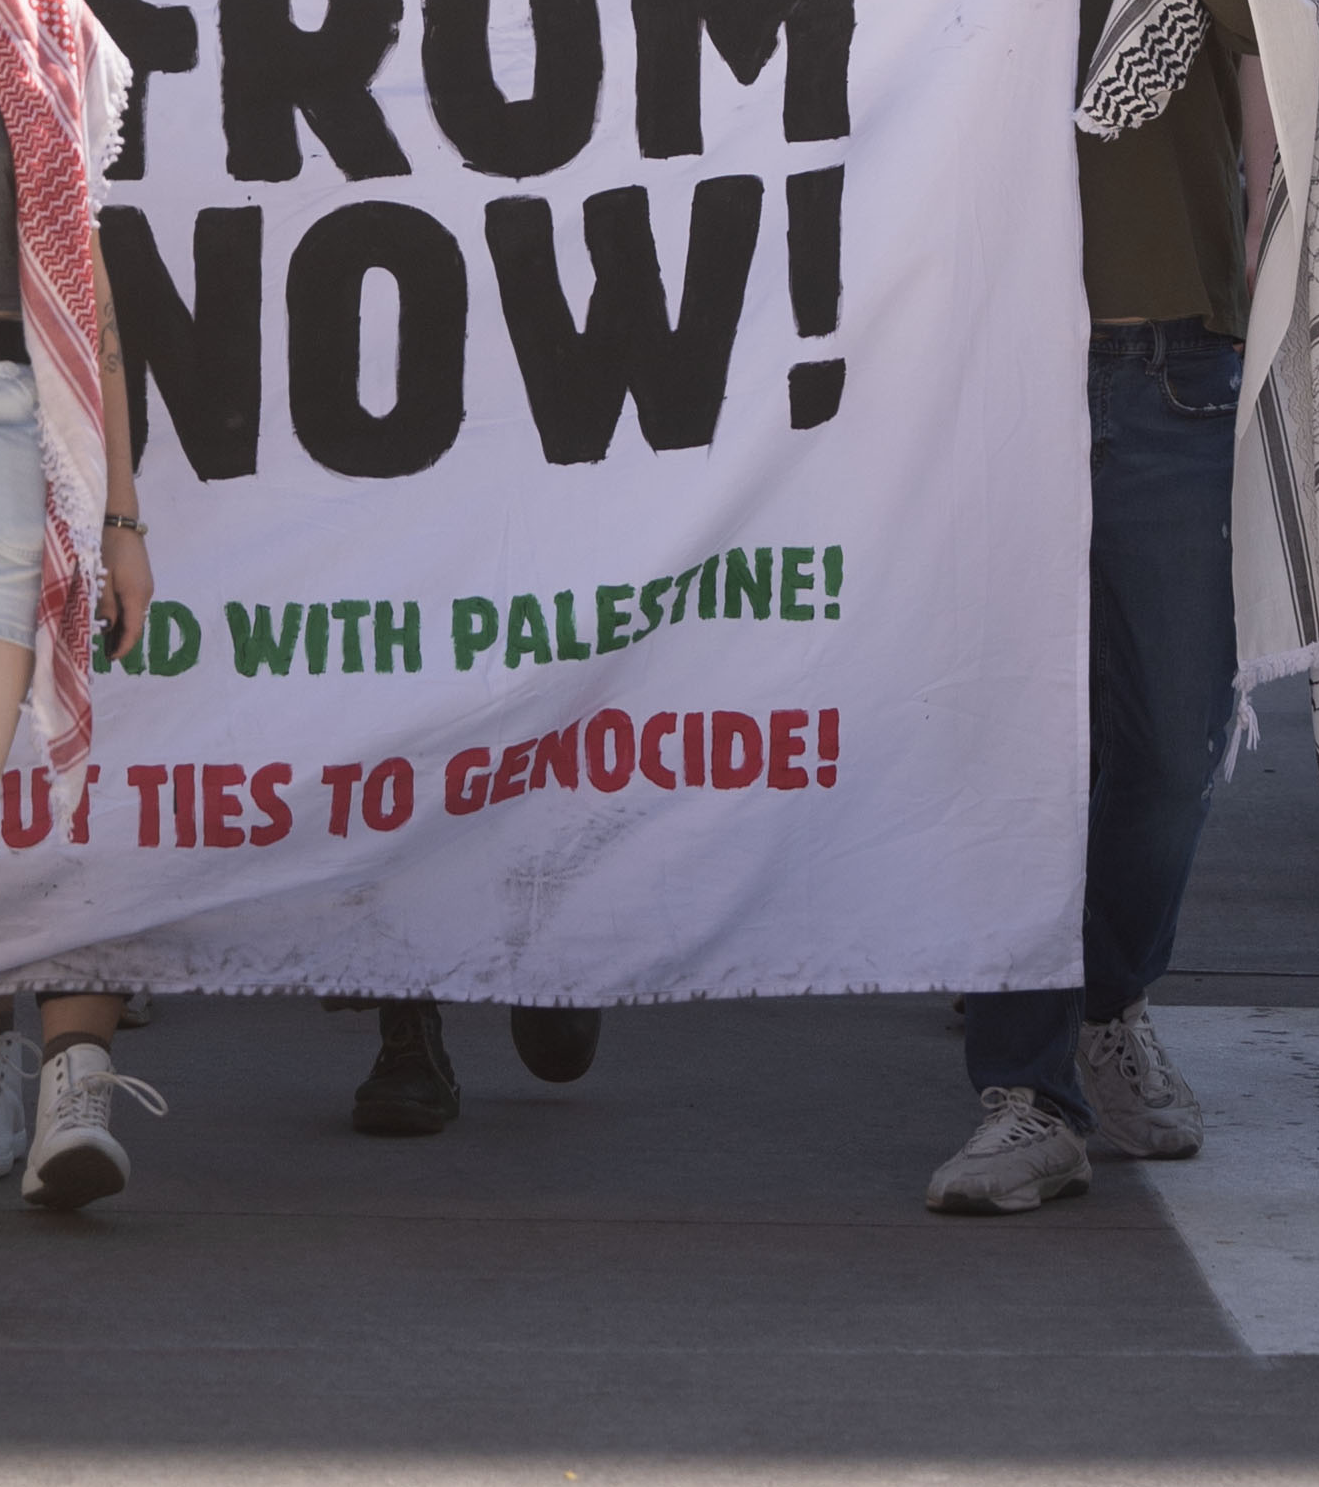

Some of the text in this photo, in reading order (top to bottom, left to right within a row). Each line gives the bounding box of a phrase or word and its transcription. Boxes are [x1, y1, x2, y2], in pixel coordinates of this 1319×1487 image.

[98, 163, 847, 482] NOW!
[224, 597, 422, 678] WITH
[451, 544, 845, 672] PALESTINE!
[127, 762, 294, 849] TIES
[321, 757, 415, 839] TO
[444, 707, 841, 817] GENOCIDE!
